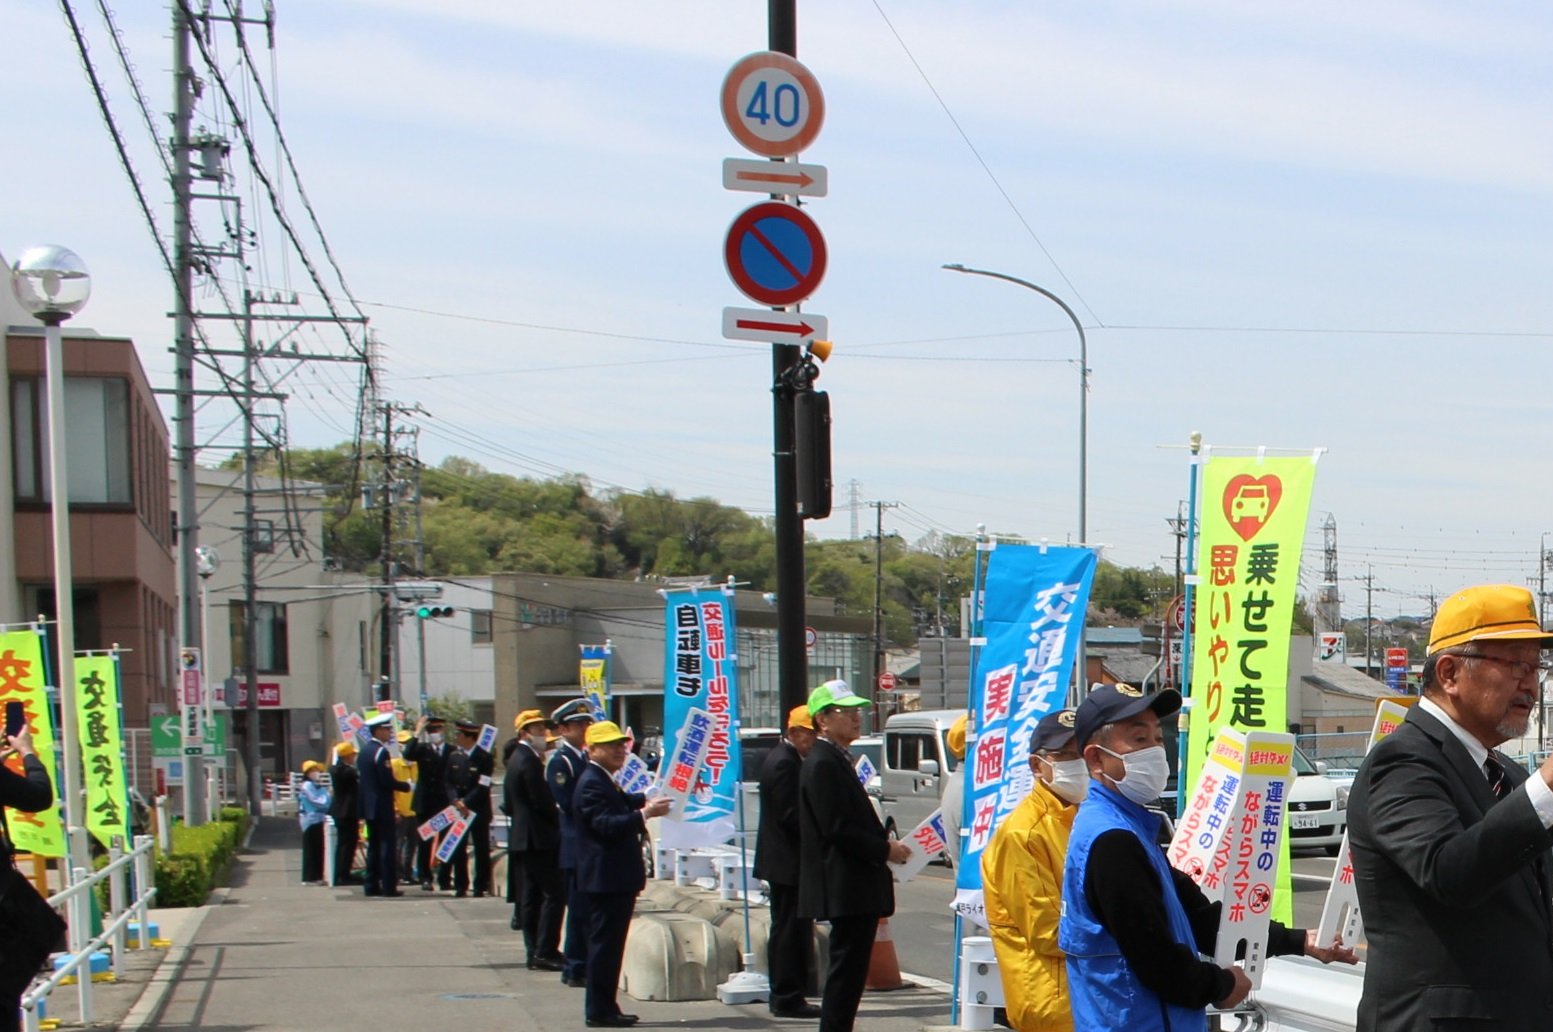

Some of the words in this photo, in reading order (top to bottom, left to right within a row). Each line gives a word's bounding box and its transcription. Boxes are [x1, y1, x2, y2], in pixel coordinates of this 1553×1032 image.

[745, 81, 800, 127] 40
[1230, 543, 1279, 728] 乗せて走
[974, 672, 1014, 846] 実施中
[996, 582, 1081, 830] 交通安全運
[1173, 775, 1218, 866] ながらスマ
[1199, 775, 1240, 850] 運転中の
[1229, 791, 1262, 923] ながらスマホ
[1257, 781, 1284, 871] 運転中の
